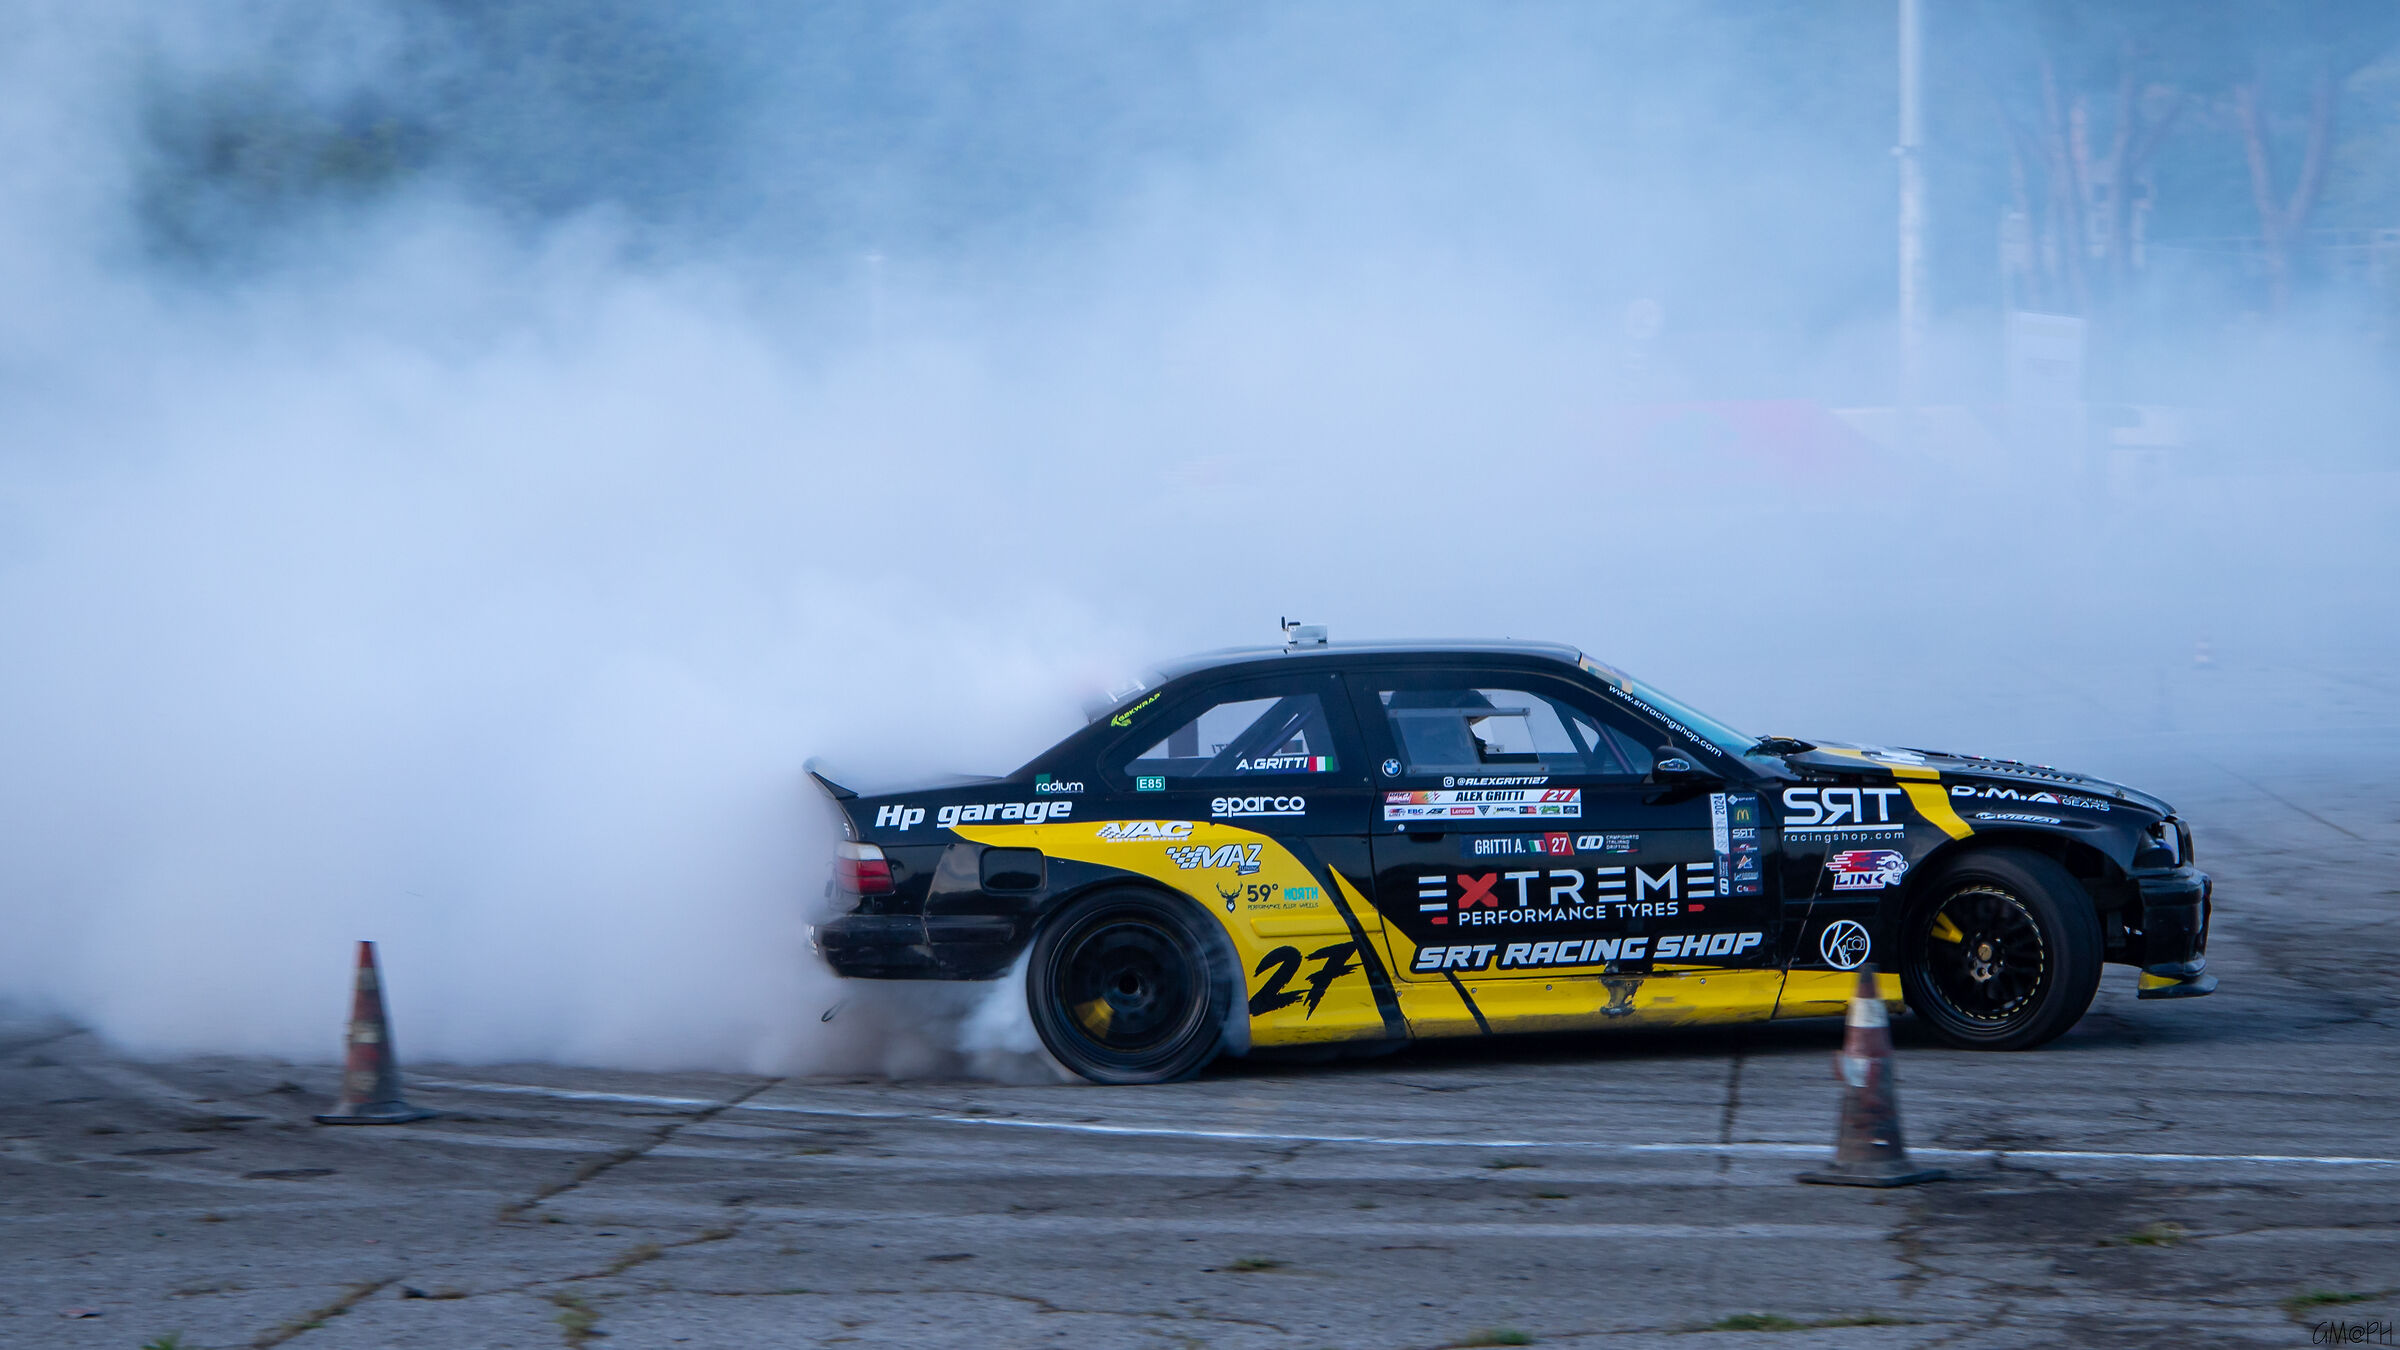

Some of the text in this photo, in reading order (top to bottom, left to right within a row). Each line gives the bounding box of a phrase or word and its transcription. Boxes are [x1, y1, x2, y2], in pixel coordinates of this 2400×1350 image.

[1609, 685, 1723, 757] www.srtracingshop.com
[1236, 757, 1308, 771] A.GRITTI
[1036, 779, 1084, 792] radium
[1139, 778, 1162, 789] E85
[1457, 776, 1548, 786] @ALEXGRITTI27
[1455, 791, 1526, 802] ALEX GRITTI
[1546, 788, 1572, 801] 27
[1211, 796, 1306, 817] sparco
[1714, 796, 1726, 815] 2024
[2062, 798, 2110, 812] GEARS
[875, 801, 1073, 832] Hp garage
[1784, 832, 1905, 844] racingshop.com
[1475, 838, 1567, 854] GRITTI A. 27
[1418, 862, 1715, 911] EXTREME
[1836, 873, 1885, 885] LINK
[1459, 901, 1678, 926] PERFORMANCE TYRES
[1415, 932, 1763, 970] SRT RACING SHOP
[1249, 941, 1362, 1021] 27
